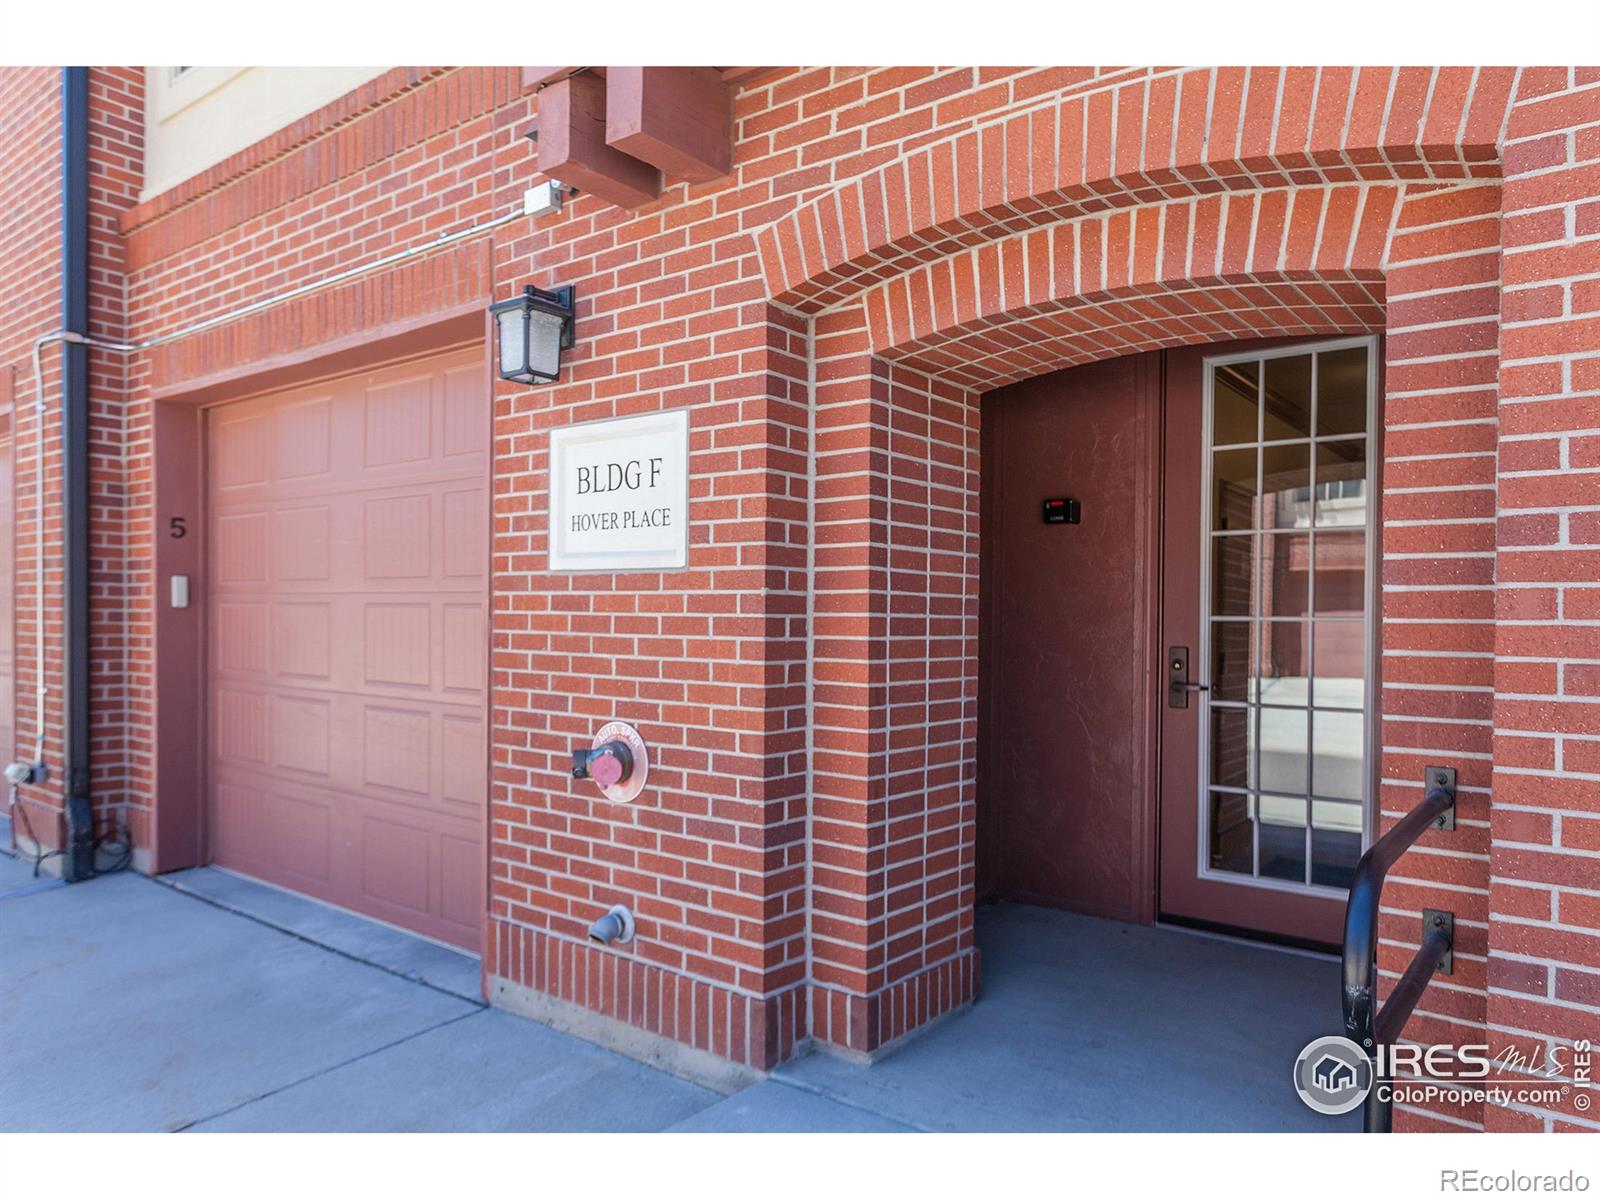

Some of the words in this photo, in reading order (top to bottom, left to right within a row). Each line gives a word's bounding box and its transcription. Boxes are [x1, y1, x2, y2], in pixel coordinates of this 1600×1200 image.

[576, 460, 642, 494] BLDG
[649, 458, 663, 488] F
[170, 517, 187, 539] 5
[571, 512, 619, 532] HOVER
[623, 508, 671, 528] PLACE
